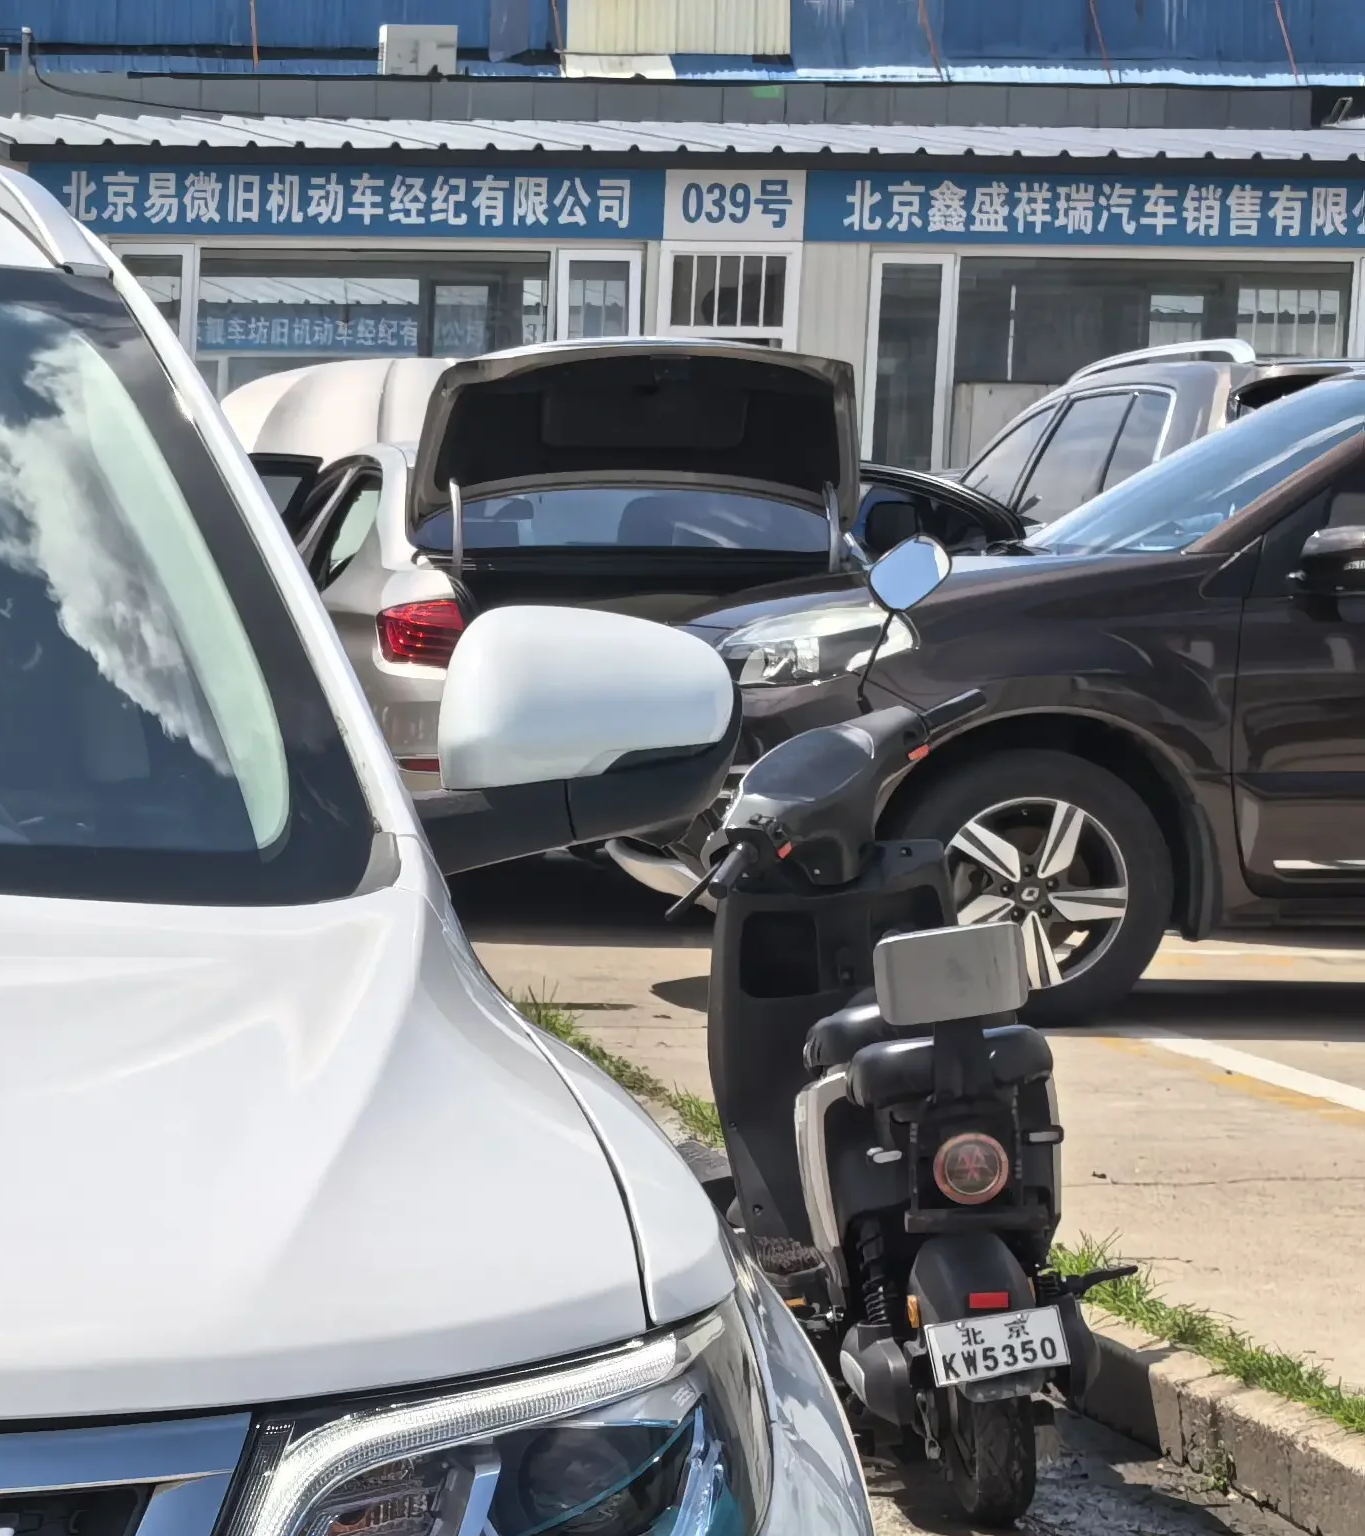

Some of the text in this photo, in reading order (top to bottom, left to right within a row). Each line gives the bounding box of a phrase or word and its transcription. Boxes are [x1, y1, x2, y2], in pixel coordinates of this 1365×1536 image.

[62, 170, 632, 228] 北京易微旧机动车经纪有限公司
[680, 180, 794, 229] 039号
[941, 1336, 1057, 1381] KW5350
